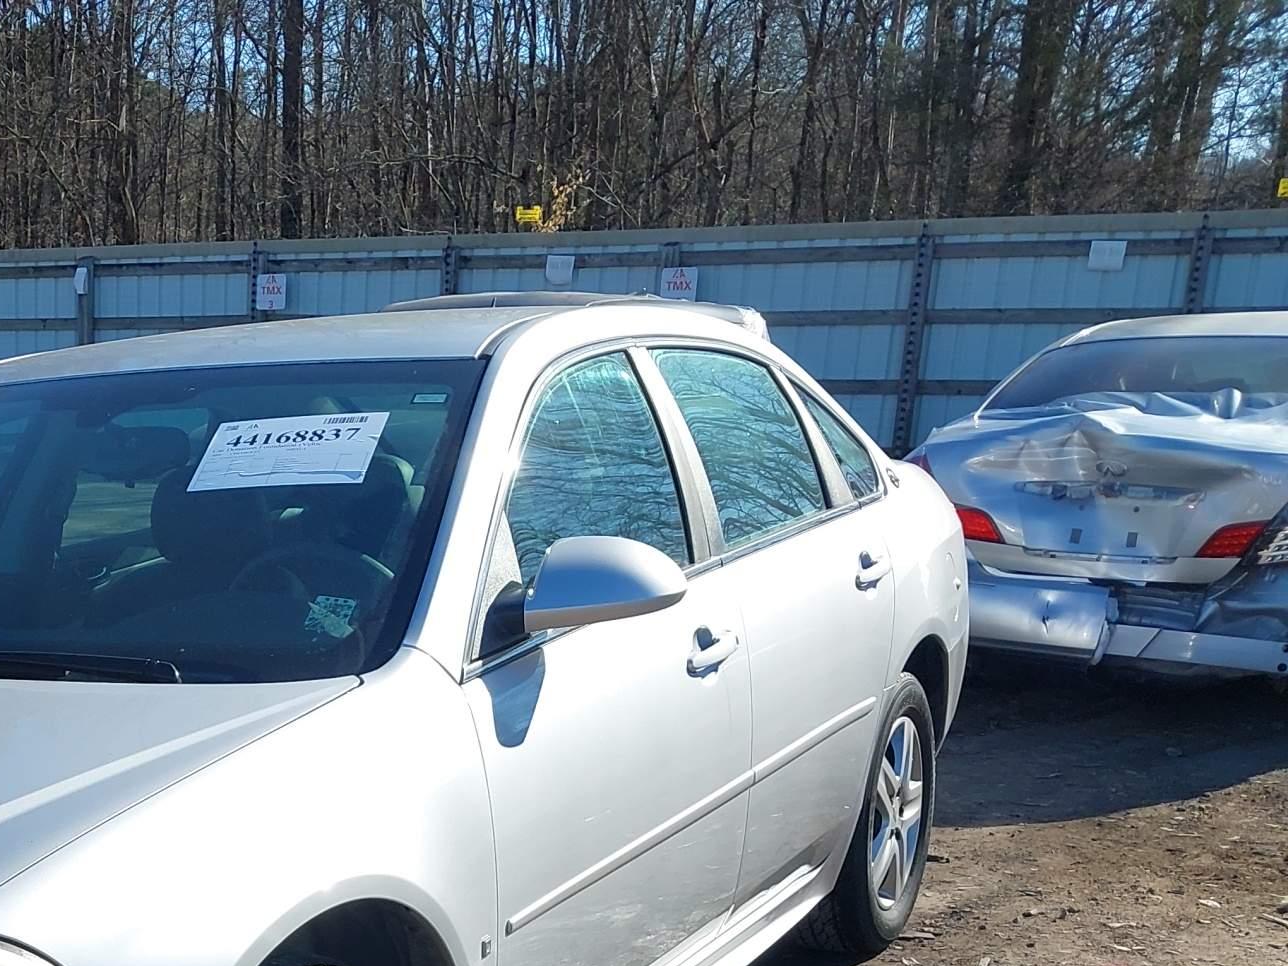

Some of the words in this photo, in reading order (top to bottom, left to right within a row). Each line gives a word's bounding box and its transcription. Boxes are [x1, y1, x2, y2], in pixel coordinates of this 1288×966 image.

[666, 280, 692, 290] TMX
[261, 286, 282, 295] TMX
[268, 300, 274, 309] 3
[226, 428, 361, 447] 44168837
